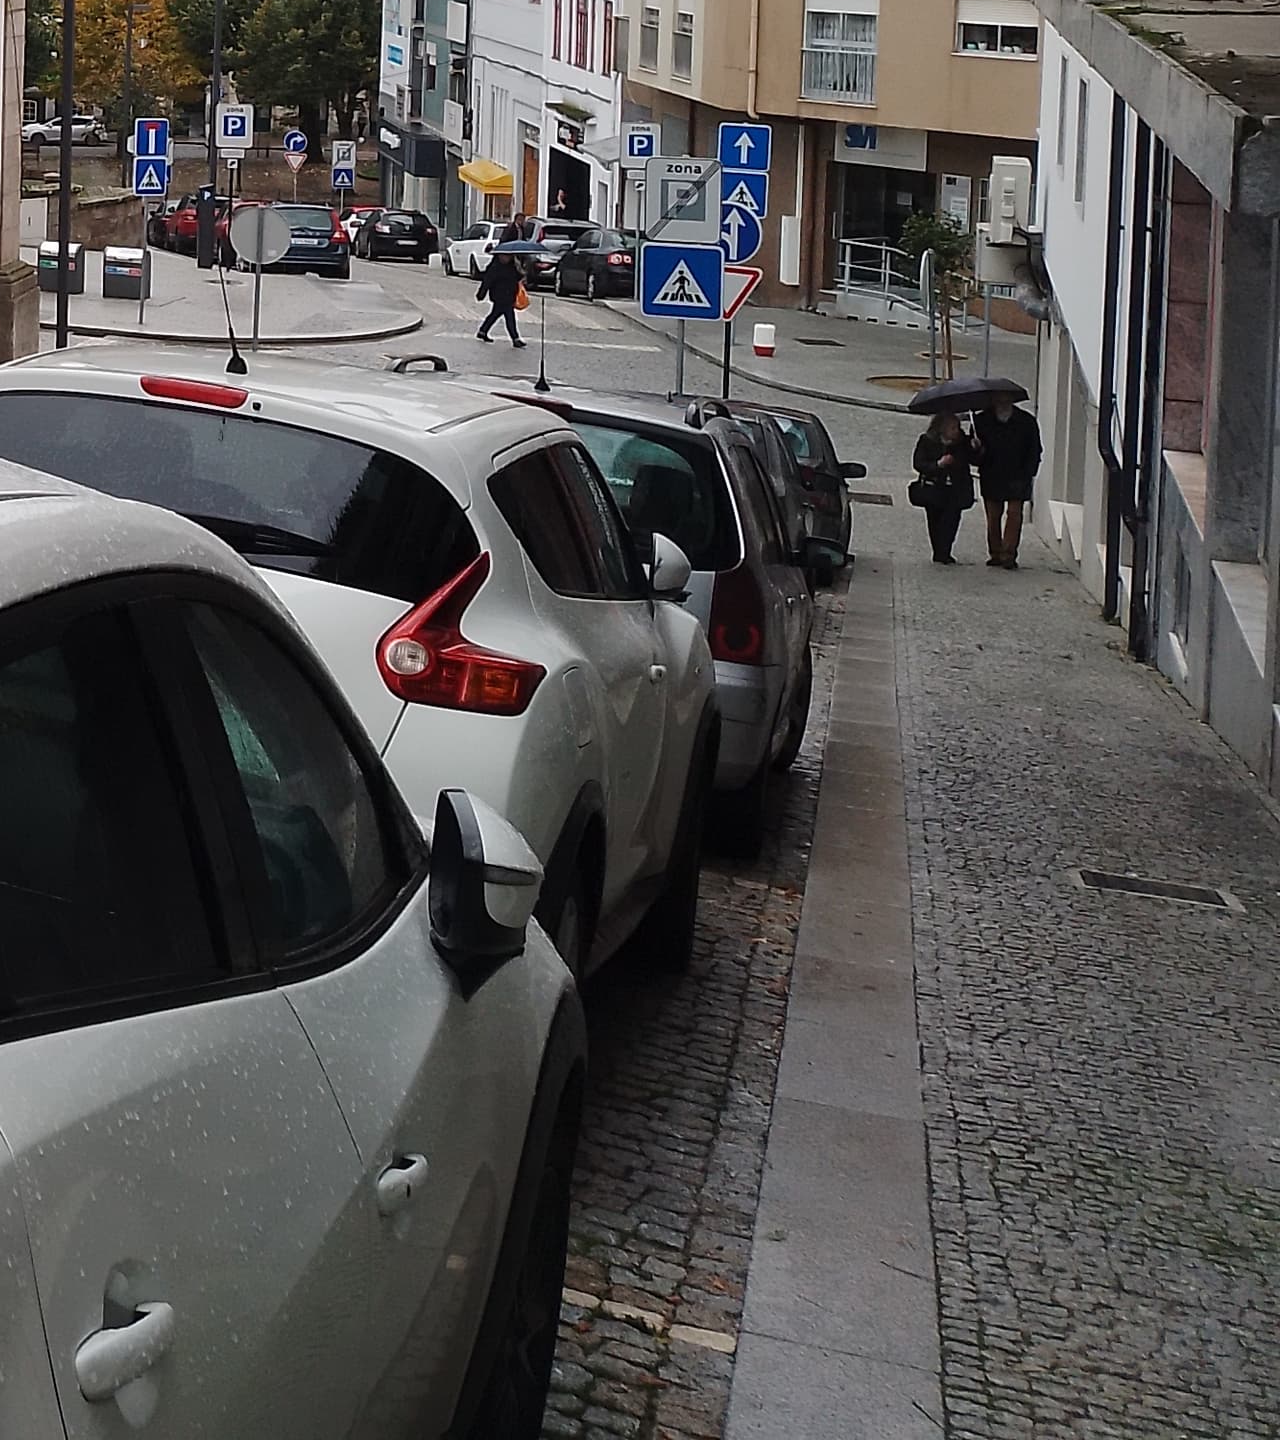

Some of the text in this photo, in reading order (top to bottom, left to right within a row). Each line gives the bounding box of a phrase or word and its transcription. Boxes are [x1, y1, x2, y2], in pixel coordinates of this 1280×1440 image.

[227, 117, 241, 135] P
[633, 136, 648, 155] P
[666, 163, 702, 175] zona
[204, 191, 211, 200] P
[668, 181, 698, 219] P
